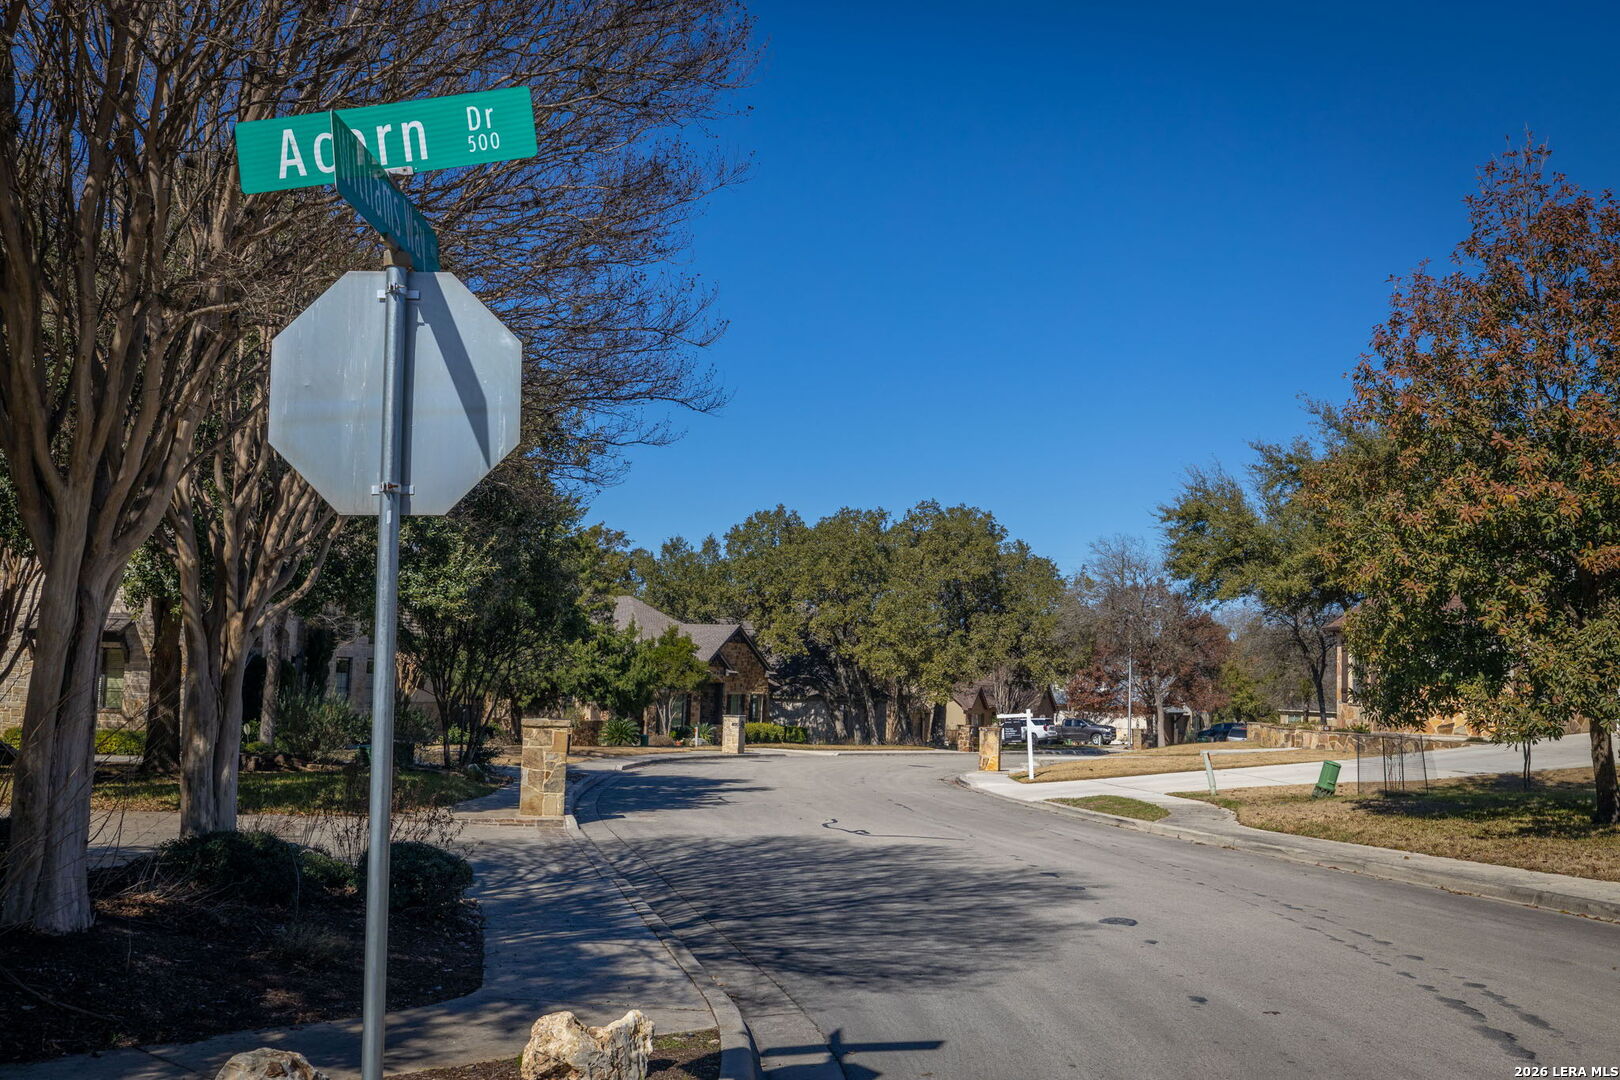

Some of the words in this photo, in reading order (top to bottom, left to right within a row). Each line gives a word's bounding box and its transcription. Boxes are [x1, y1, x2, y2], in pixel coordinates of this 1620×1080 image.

[279, 120, 428, 179] Acrn
[466, 106, 494, 131] Dr
[467, 132, 500, 153] 500
[337, 122, 401, 237] Williams
